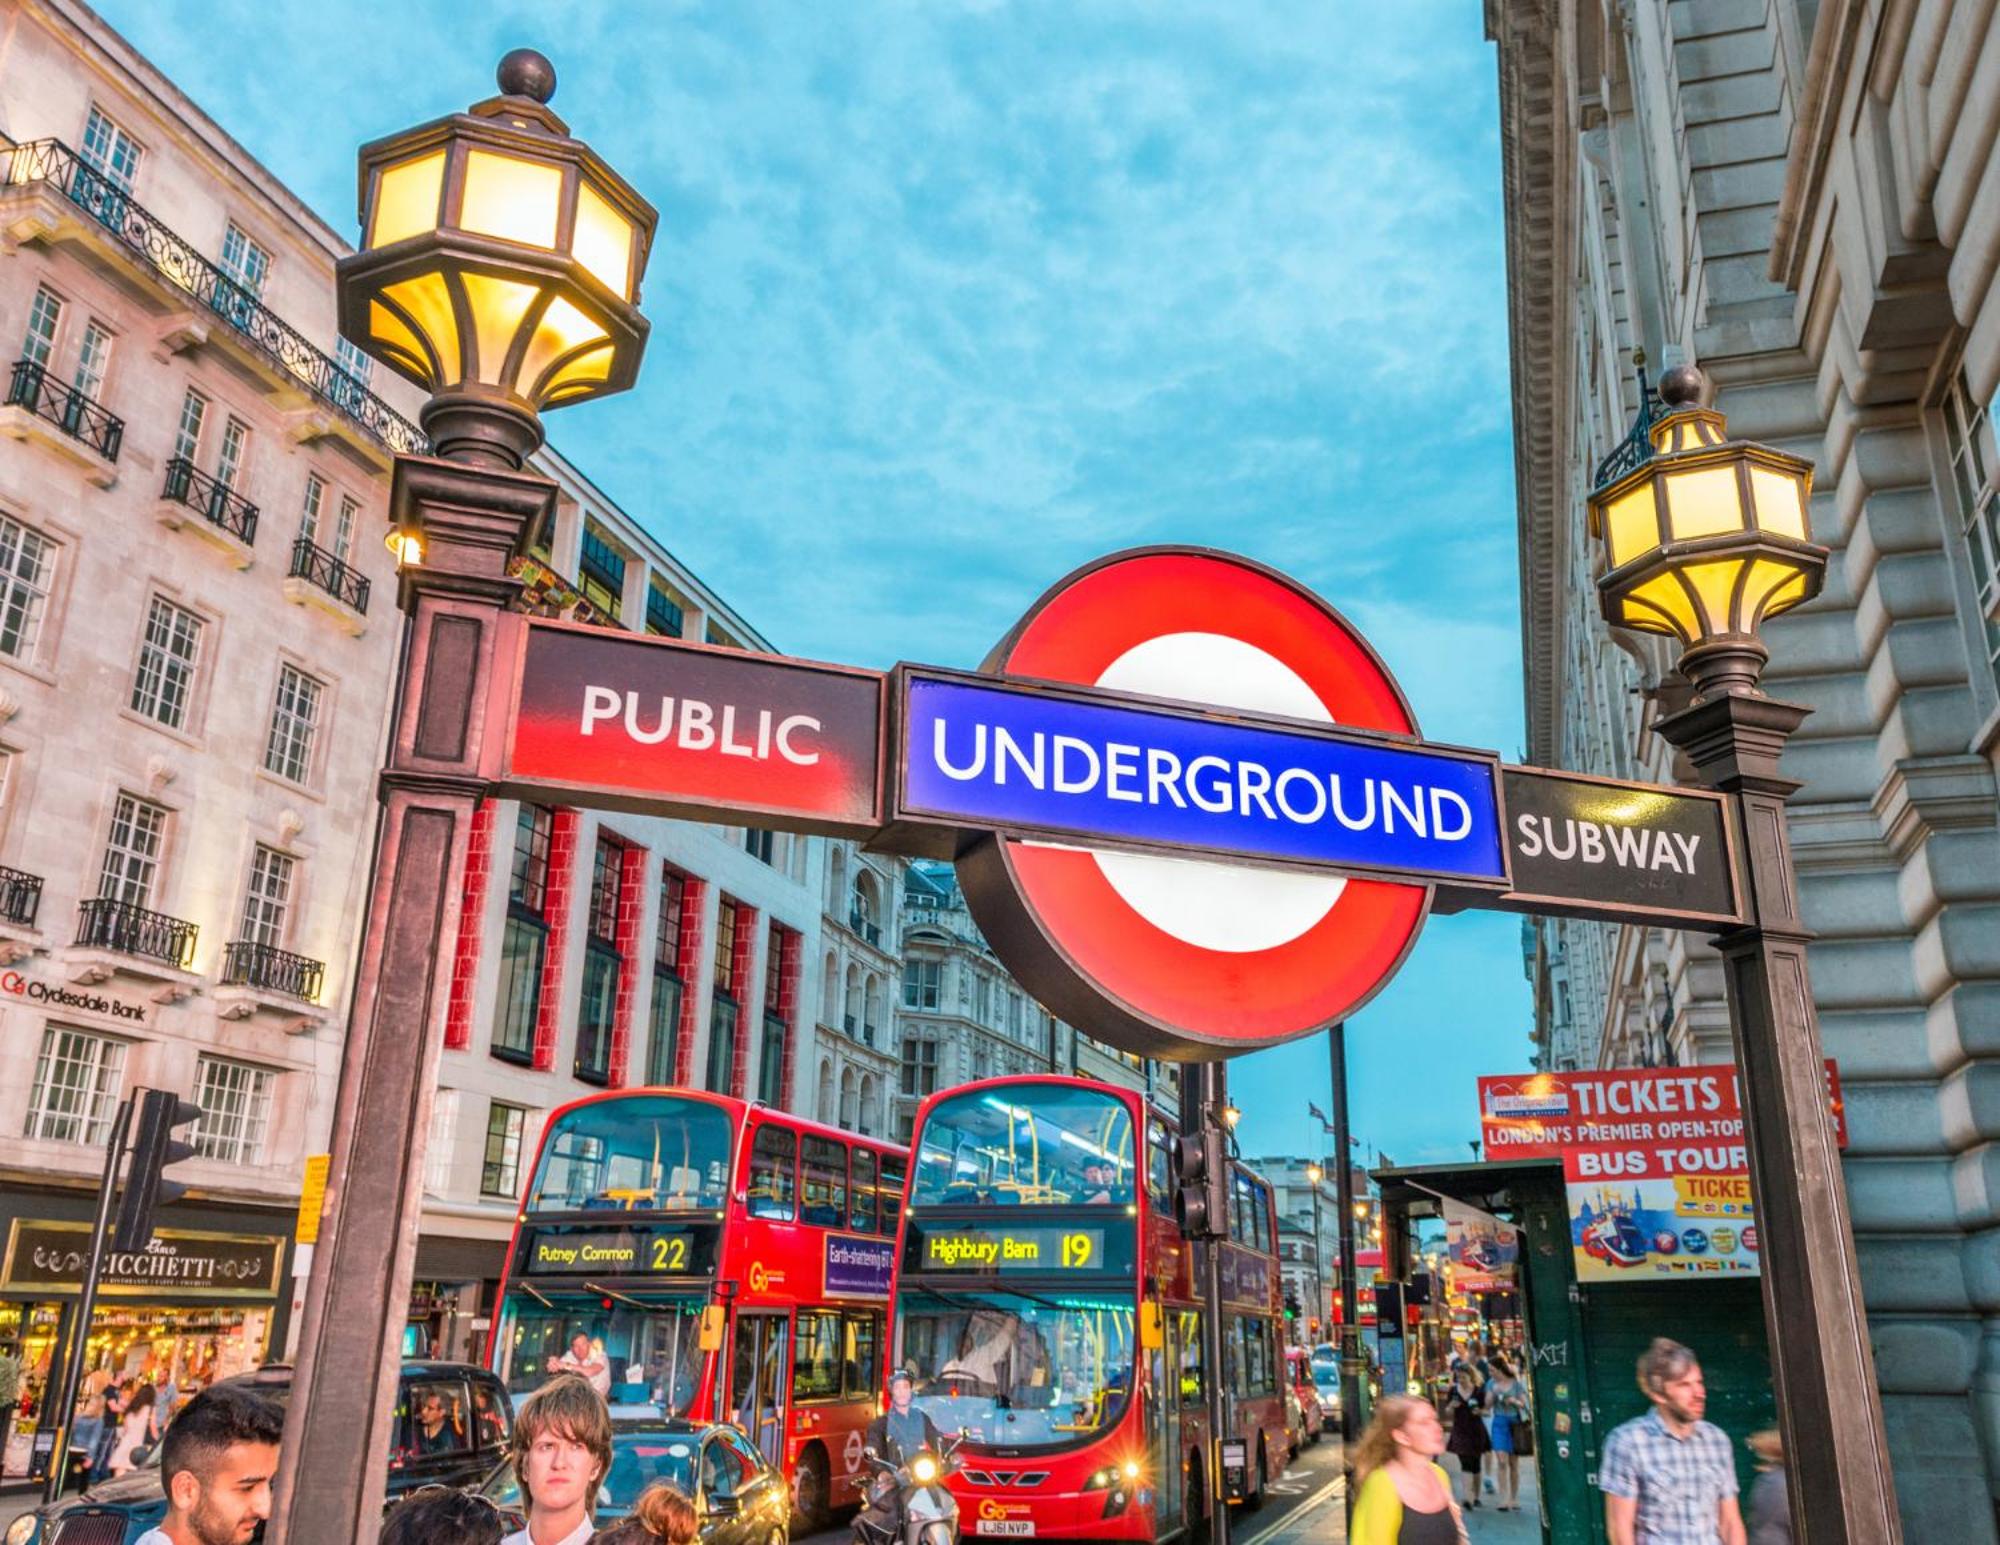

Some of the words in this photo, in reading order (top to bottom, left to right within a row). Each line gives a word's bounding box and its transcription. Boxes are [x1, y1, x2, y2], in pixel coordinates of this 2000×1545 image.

[579, 685, 821, 765] PUBLIC
[933, 718, 1473, 841] UNDERGROUND
[1517, 813, 1700, 875] SUBWAY
[28, 981, 109, 1013] Clydesdale
[111, 1000, 146, 1021] Bank
[1571, 1076, 1720, 1115] TICKETS
[1488, 1126, 1572, 1146] LONDON'S
[1577, 1122, 1653, 1142] PREMIER
[1577, 1151, 1648, 1176] BUS
[1656, 1147, 1748, 1173] TOUR
[538, 1245, 578, 1265] Putney
[581, 1245, 634, 1262] Common
[652, 1238, 685, 1269] 22
[930, 1237, 998, 1265] Highbury
[1002, 1237, 1038, 1258] Barn
[1062, 1233, 1091, 1267] 19
[1007, 1523, 1029, 1534] NVP
